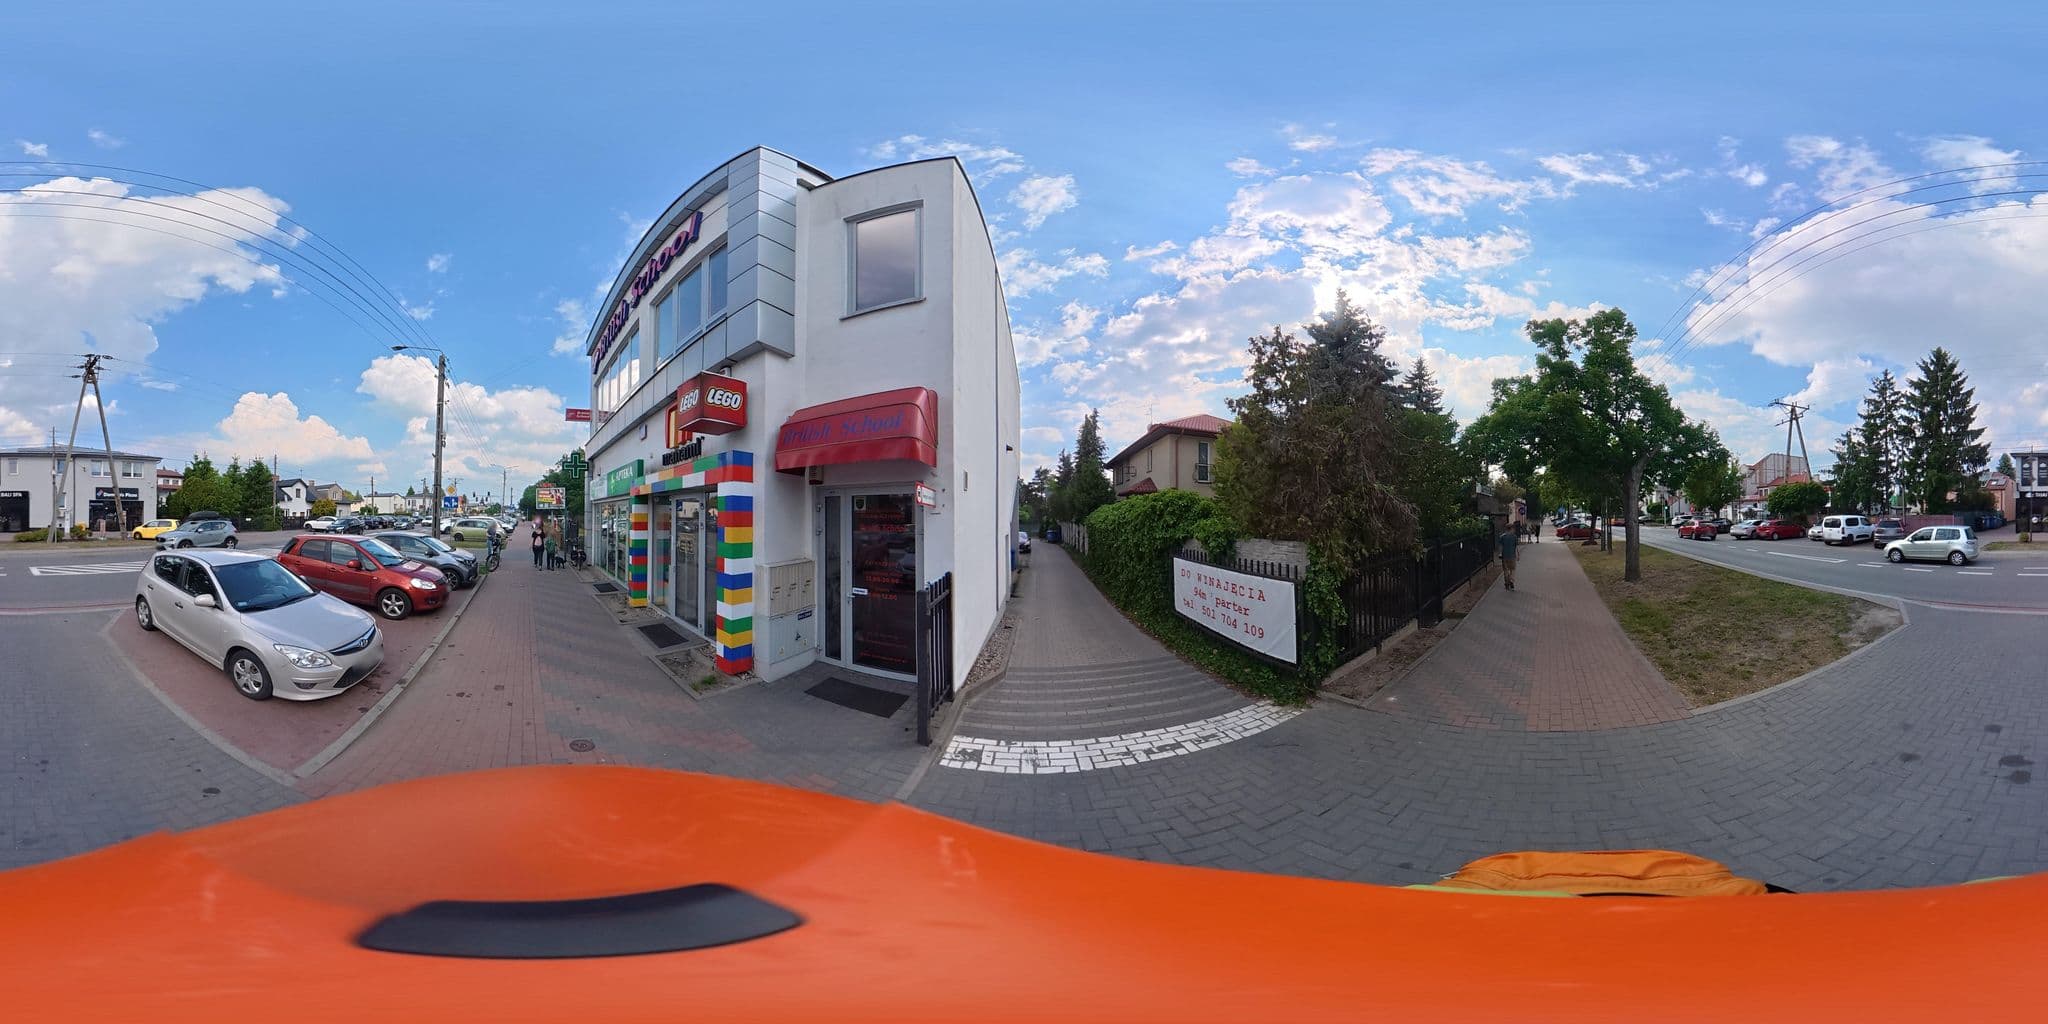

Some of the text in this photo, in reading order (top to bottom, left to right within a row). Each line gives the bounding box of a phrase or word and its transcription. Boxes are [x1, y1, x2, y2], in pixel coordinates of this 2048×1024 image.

[630, 211, 703, 308] School
[680, 388, 699, 412] LEGO
[706, 387, 742, 409] LEGO
[784, 410, 905, 445] British School
[1181, 568, 1191, 578] DO
[1215, 597, 1250, 616] parter
[1202, 605, 1216, 620] 501
[1221, 613, 1237, 629] 704
[1244, 622, 1264, 639] 109
